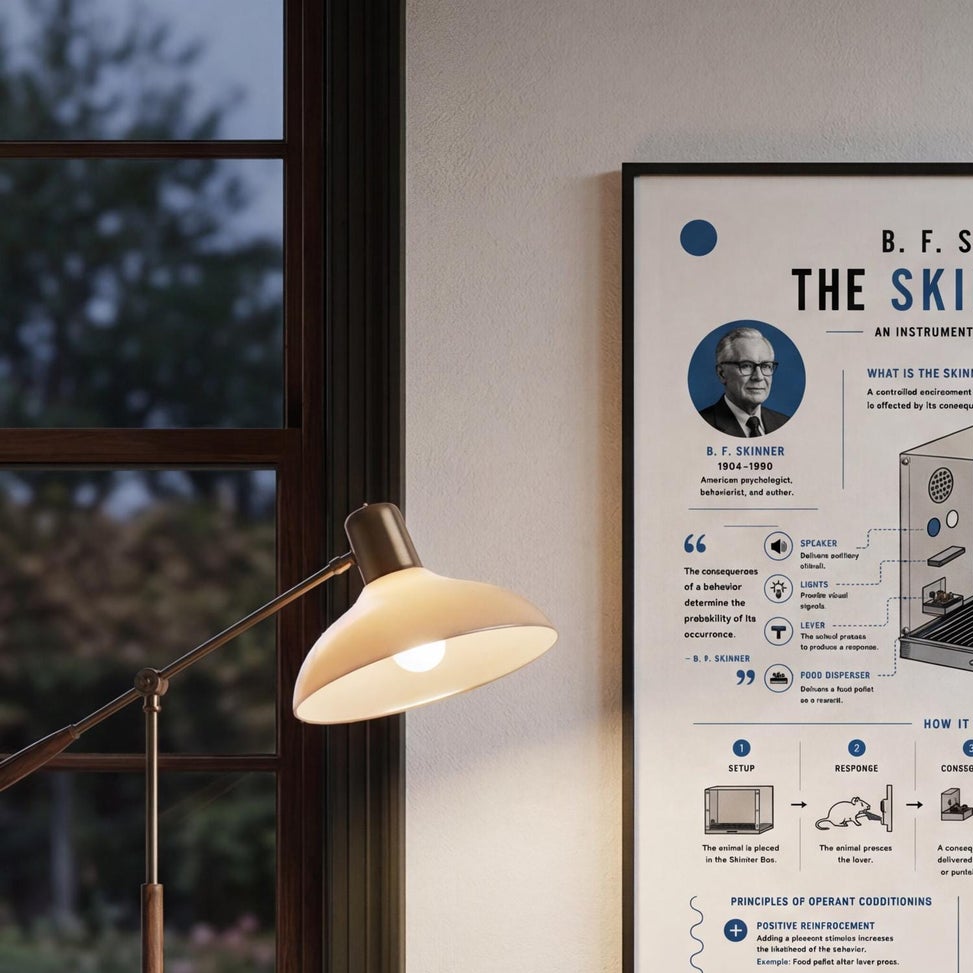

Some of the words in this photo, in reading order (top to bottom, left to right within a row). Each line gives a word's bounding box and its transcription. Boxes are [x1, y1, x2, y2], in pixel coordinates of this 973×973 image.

[882, 230, 904, 253] B.
[922, 230, 941, 253] F.
[792, 268, 865, 311] THE
[875, 327, 890, 337] AN
[896, 327, 973, 337] INSTRUMENT
[867, 368, 899, 378] WHAT
[904, 368, 914, 378] IS
[918, 368, 939, 378] THE
[914, 402, 923, 410] by
[707, 446, 717, 456] B.
[722, 446, 731, 456] F.
[736, 446, 784, 456] SKINNER
[684, 567, 700, 575] The
[684, 598, 728, 606] determine
[734, 614, 743, 622] of
[924, 719, 951, 729] HOW
[959, 719, 969, 729] IT
[740, 743, 744, 753] 1
[853, 743, 860, 753] 2
[731, 897, 788, 906] PRINCIPLES
[793, 897, 805, 906] OF
[809, 897, 855, 906] OPERANT
[757, 922, 797, 930] POSITIVE
[801, 922, 875, 930] REINFROCEMENT
[757, 935, 783, 943] Adding
